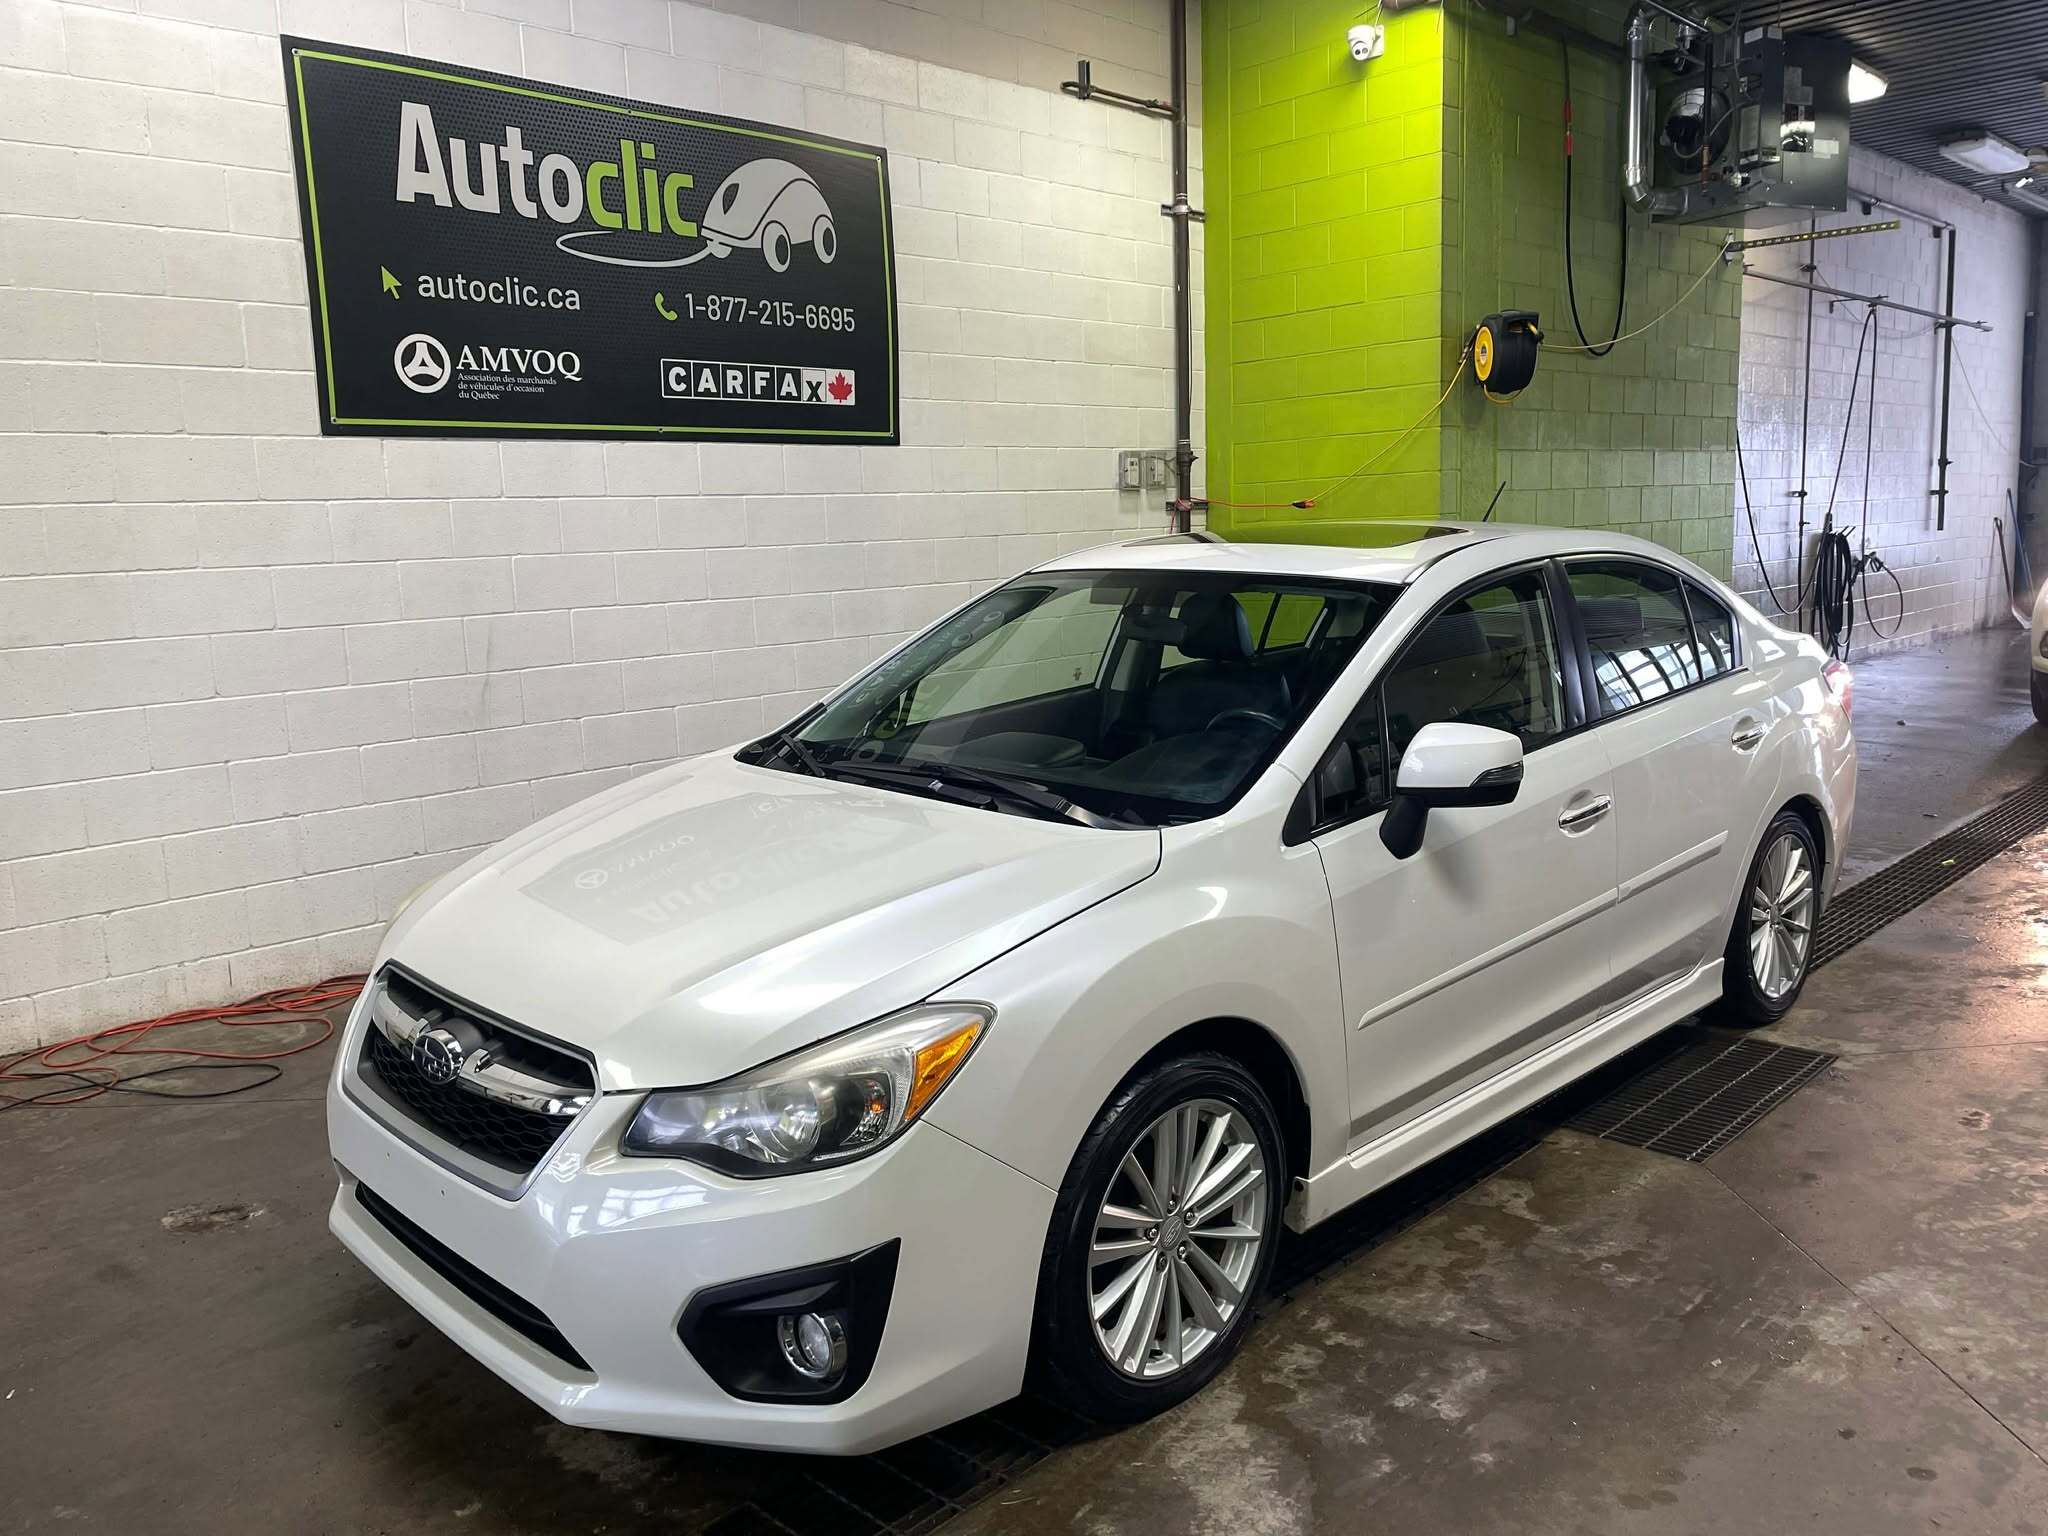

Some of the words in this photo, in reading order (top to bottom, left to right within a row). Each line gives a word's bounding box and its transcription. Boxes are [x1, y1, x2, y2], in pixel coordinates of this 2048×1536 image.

[397, 101, 698, 238] Autoclic
[418, 274, 580, 311] autoclic.ca
[685, 293, 855, 332] 1-877-215-6695
[456, 345, 582, 381] AMVOQ
[457, 373, 500, 382] Association
[502, 375, 516, 383] des
[517, 377, 557, 385] marchands
[458, 391, 469, 399] du
[471, 391, 500, 400] Québec
[469, 382, 505, 391] véhicules
[506, 383, 545, 393] d'occasion
[668, 366, 823, 402] CARFAX
